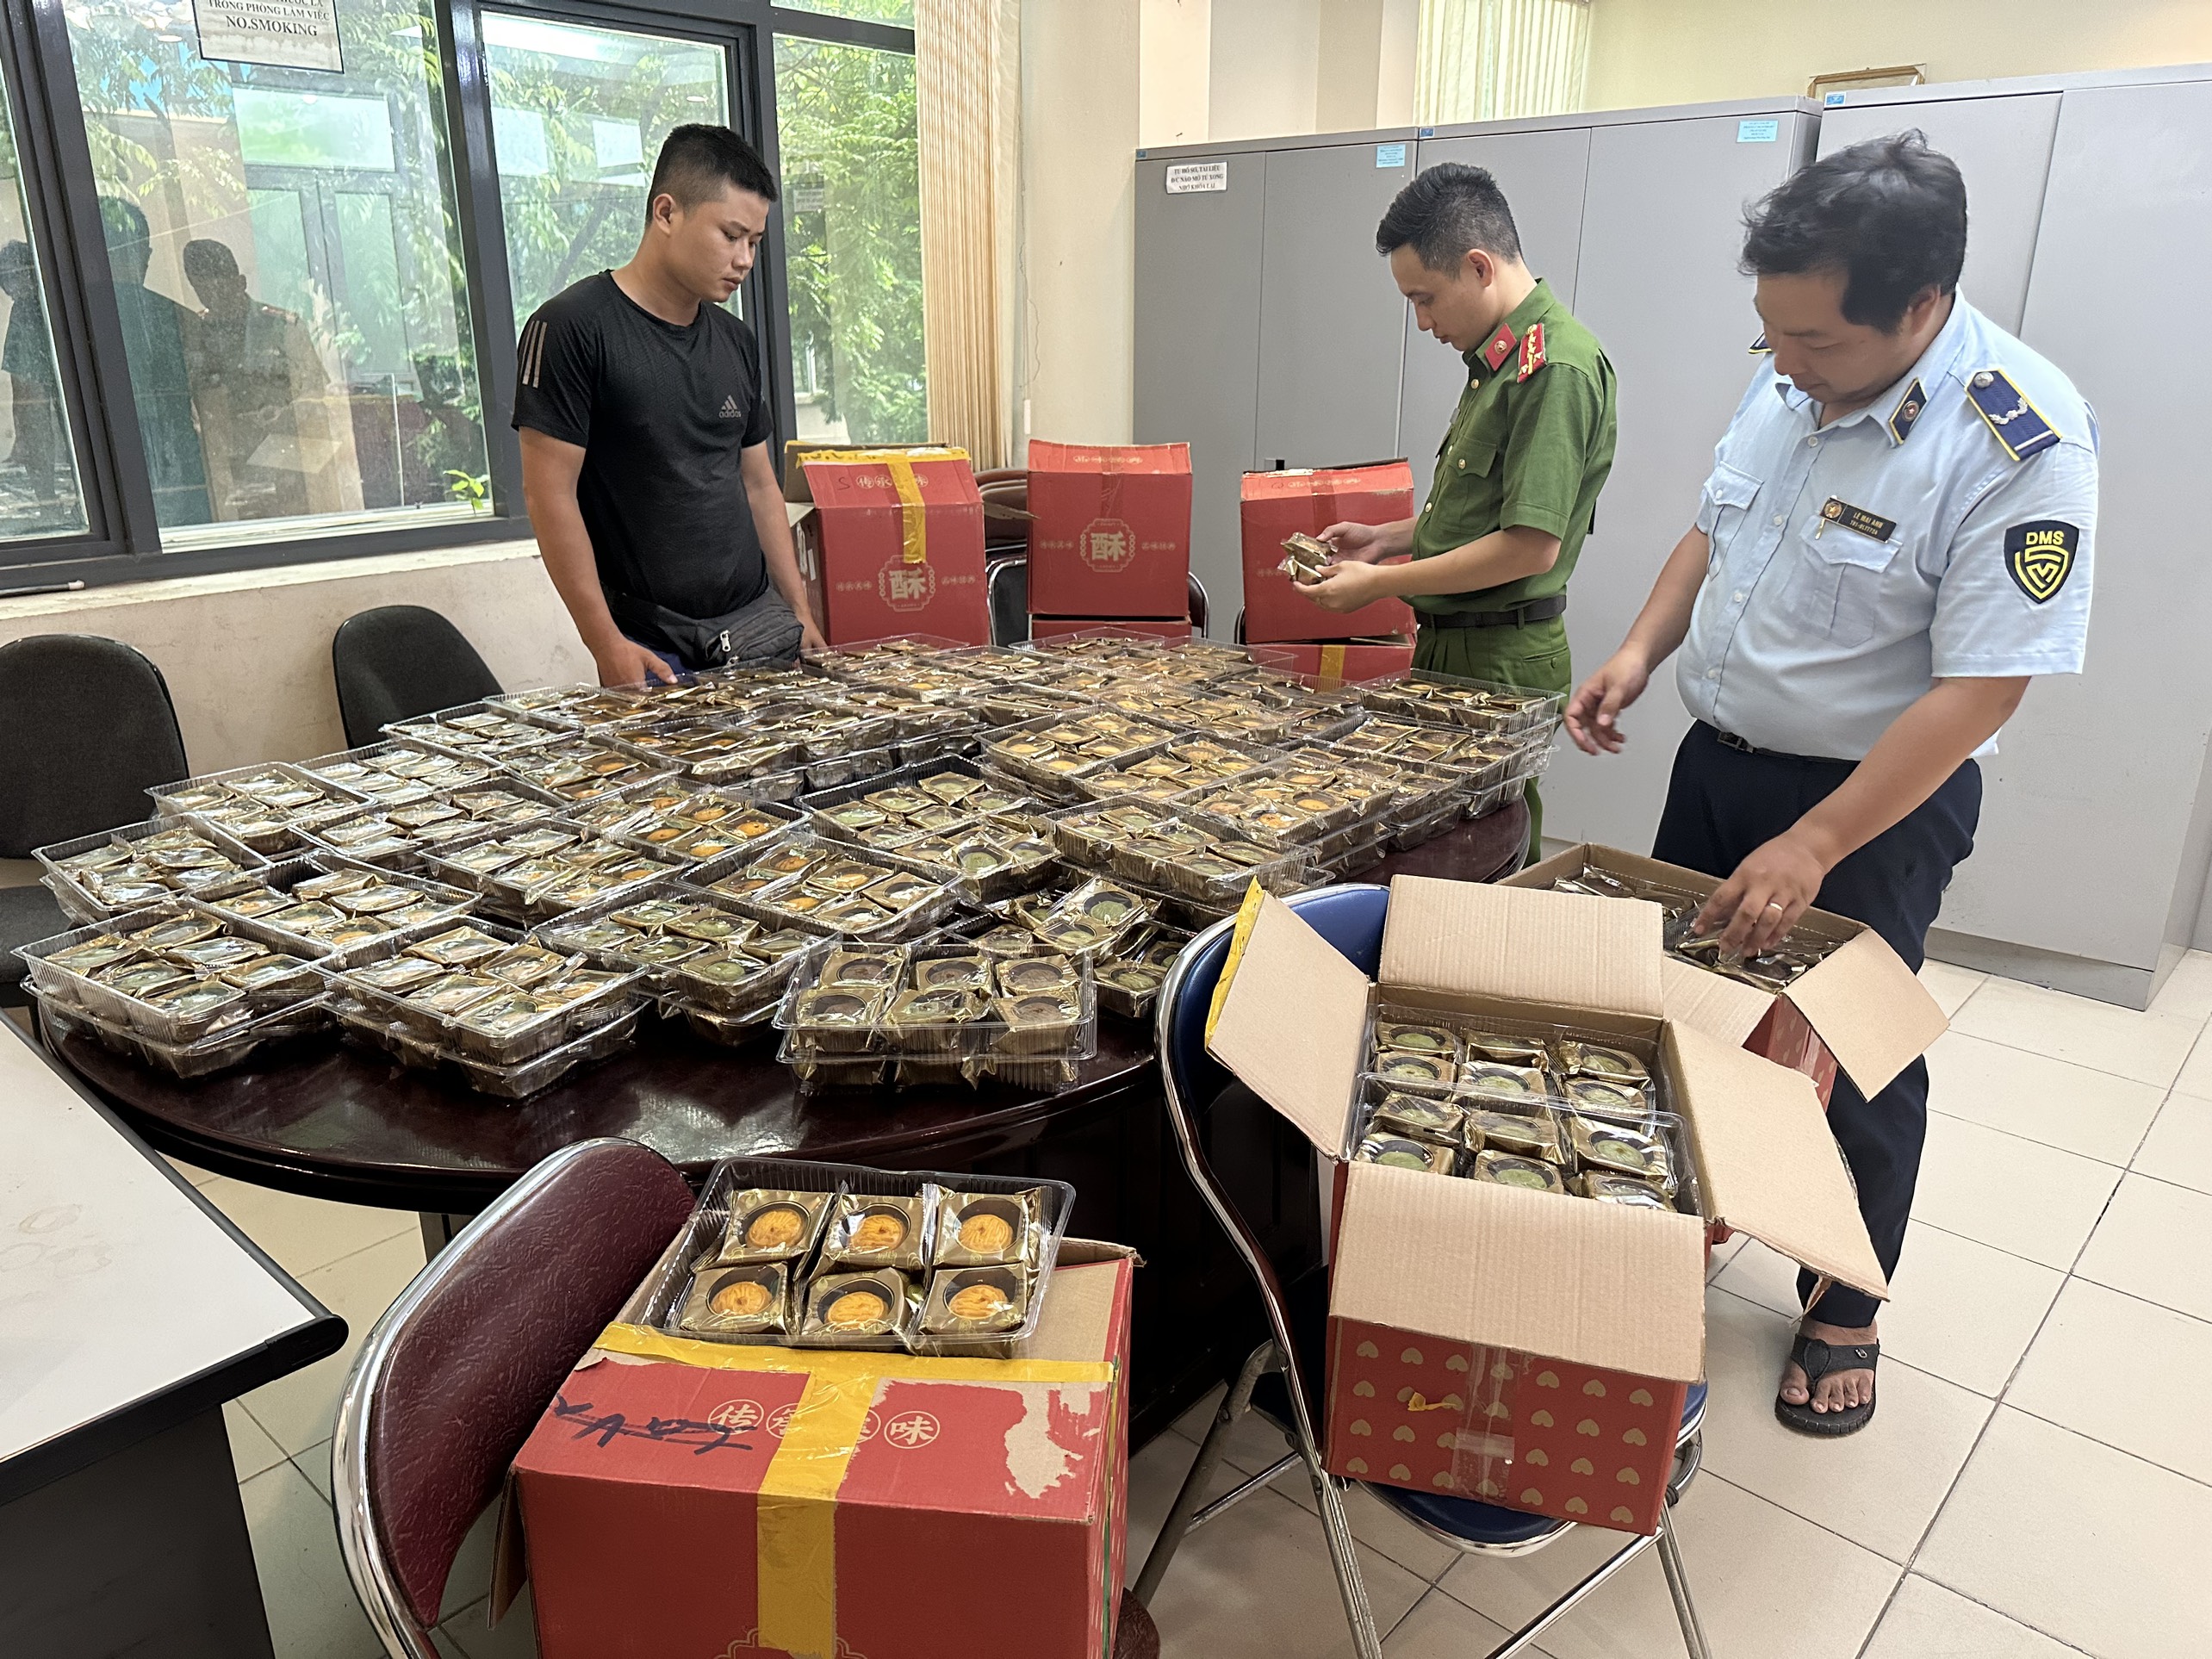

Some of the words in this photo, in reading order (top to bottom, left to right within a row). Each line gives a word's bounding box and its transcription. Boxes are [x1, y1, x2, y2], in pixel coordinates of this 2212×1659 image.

[208, 0, 244, 10] TRONG
[246, 3, 281, 15] PHÒNG
[283, 5, 305, 17] LÀM
[308, 9, 330, 21] VIỆC
[226, 16, 317, 36] NO.SMOKING
[719, 409, 742, 419] adidas
[1090, 531, 1127, 562] 酥
[2026, 531, 2065, 545] DMS
[888, 568, 928, 600] 酥
